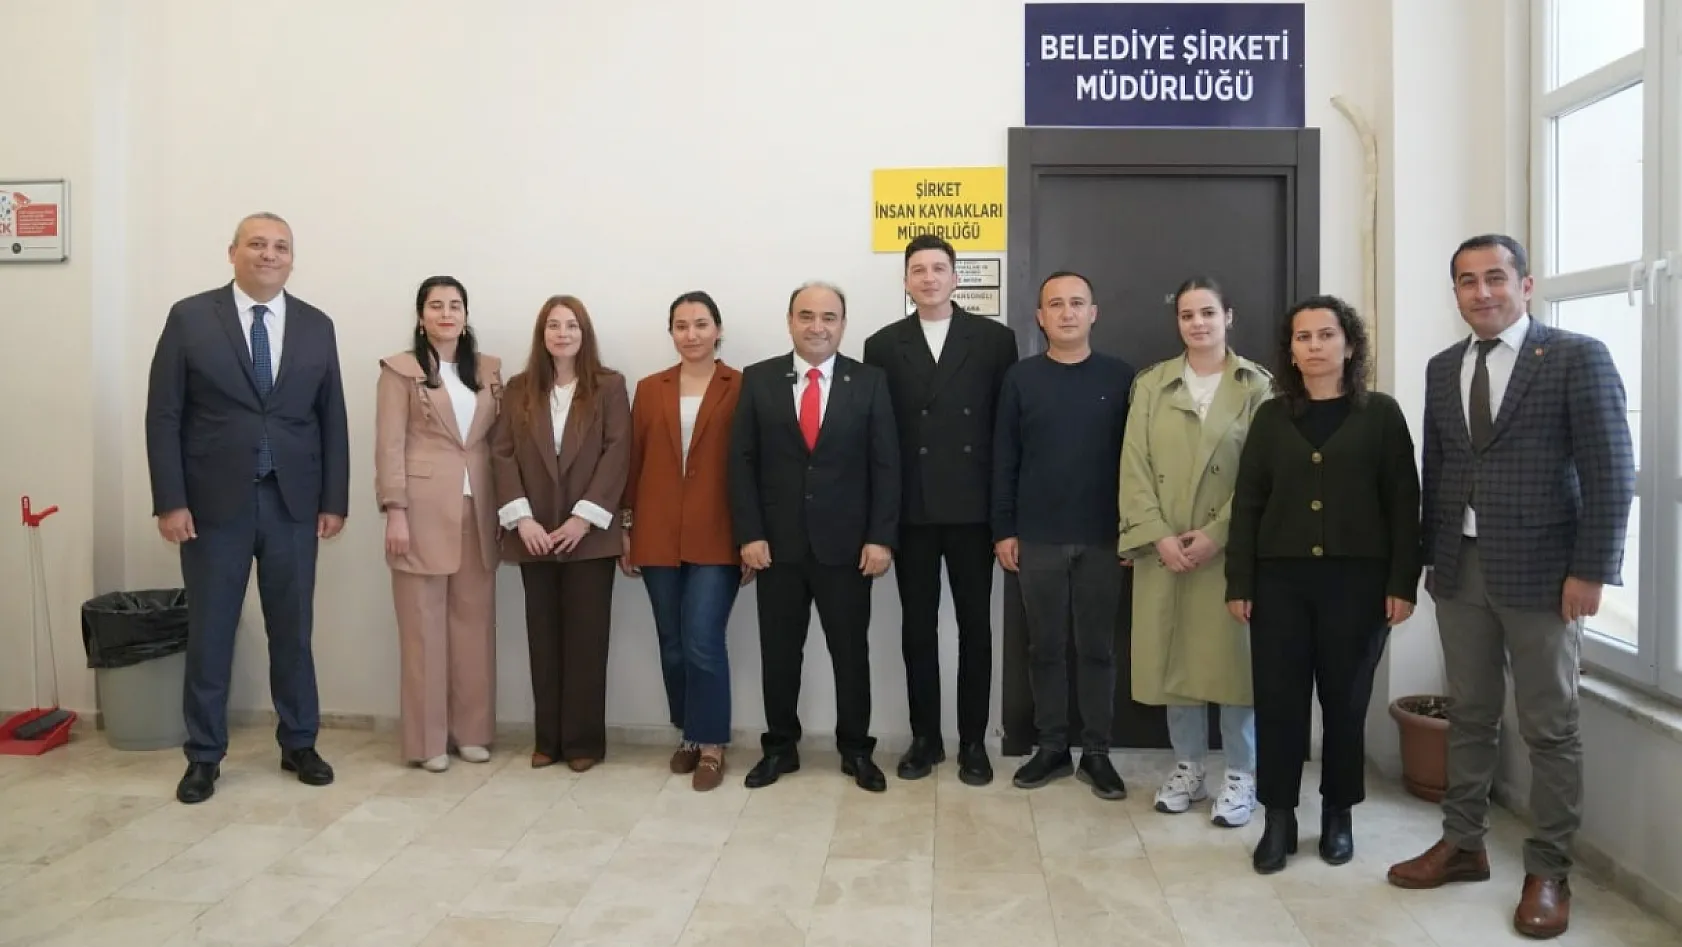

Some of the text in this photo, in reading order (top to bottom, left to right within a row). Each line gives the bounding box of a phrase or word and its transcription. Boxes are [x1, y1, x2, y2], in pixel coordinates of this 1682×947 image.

[1040, 28, 1289, 65] BELEDİYE ŞİRKETİ
[1076, 69, 1254, 101] MÜDÜRLÜĞÜ
[916, 179, 962, 199] ŞİRKET
[875, 201, 1003, 219] İNSAN KAYNAKLARI
[897, 221, 981, 240] MÜDÜRLÜĞÜ
